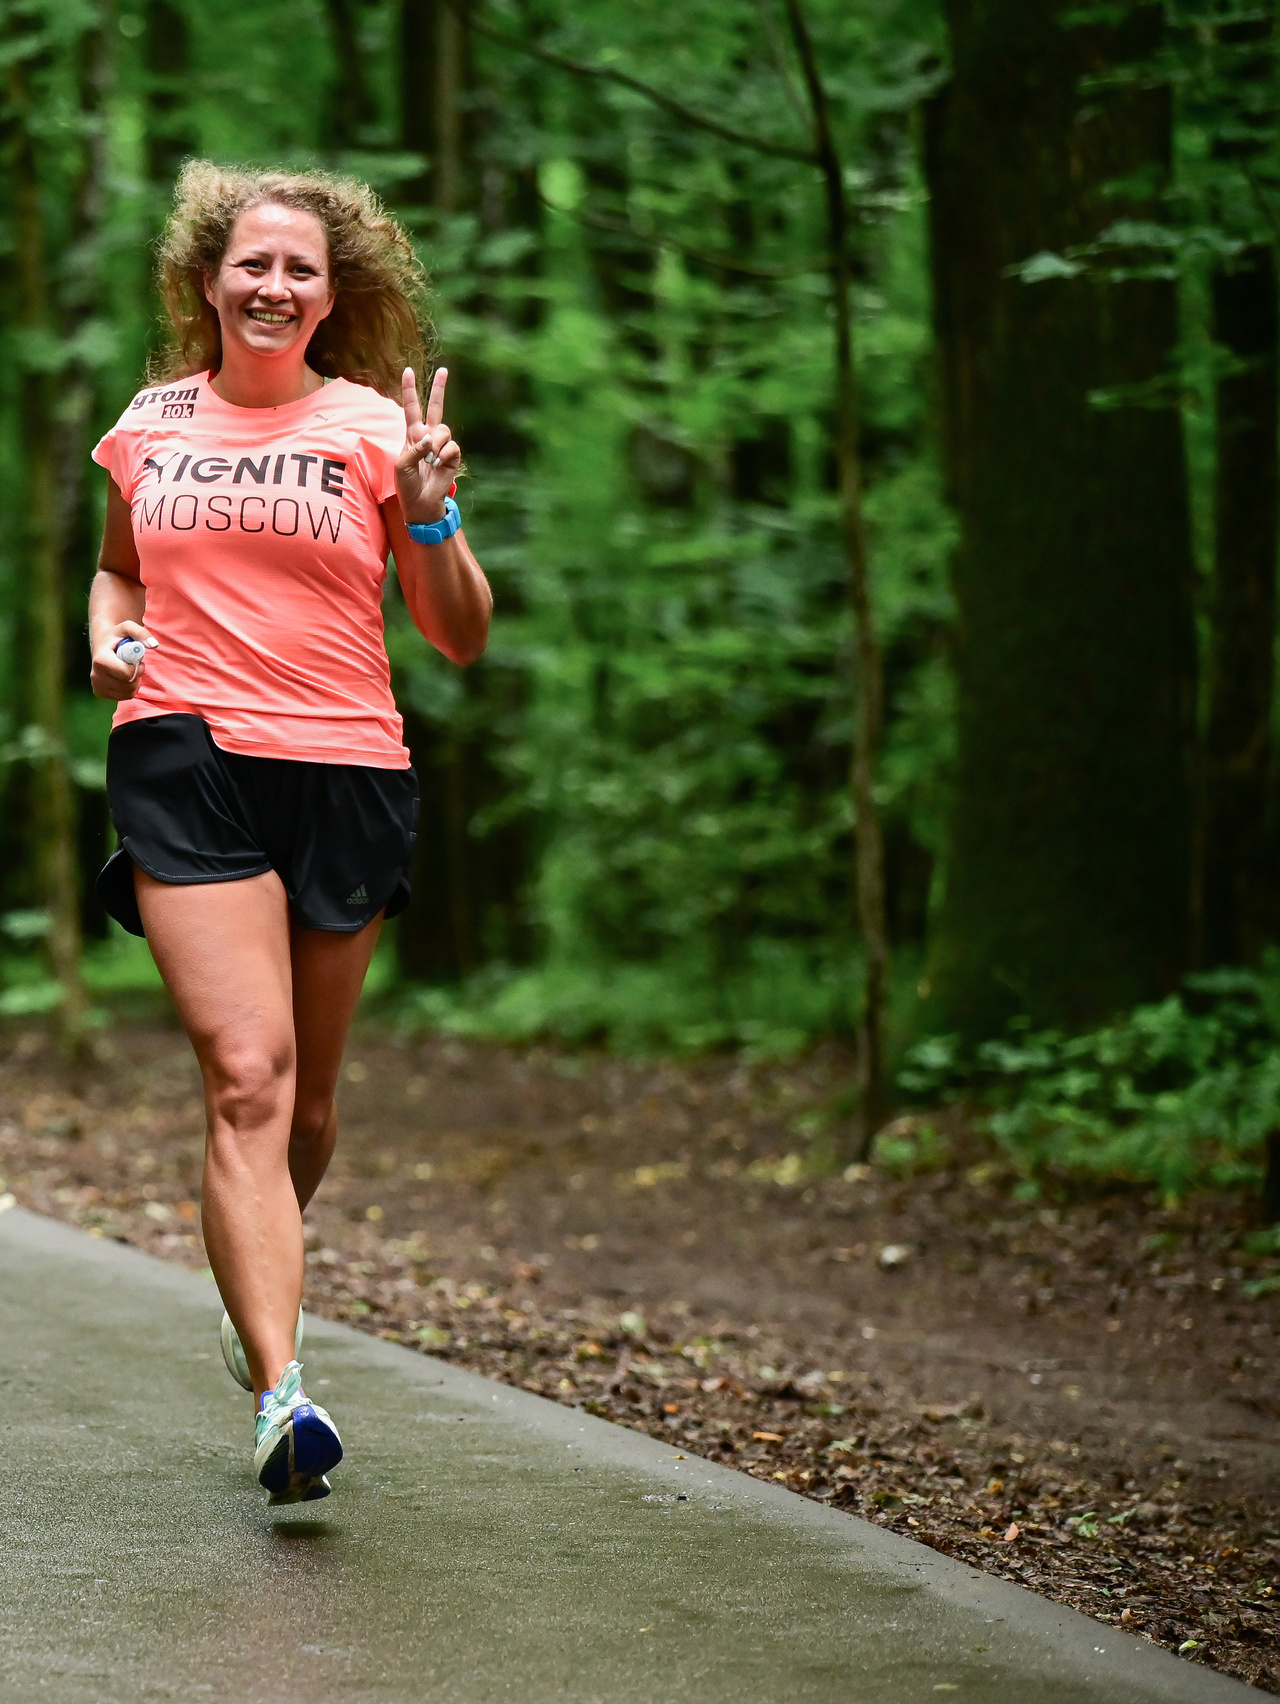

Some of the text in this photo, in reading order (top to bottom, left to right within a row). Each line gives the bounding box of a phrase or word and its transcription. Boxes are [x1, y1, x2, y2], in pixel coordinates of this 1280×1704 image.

[131, 387, 200, 410] grom
[162, 404, 193, 418] 10k
[173, 453, 347, 497] IGNITE
[139, 494, 343, 544] MOSCOW
